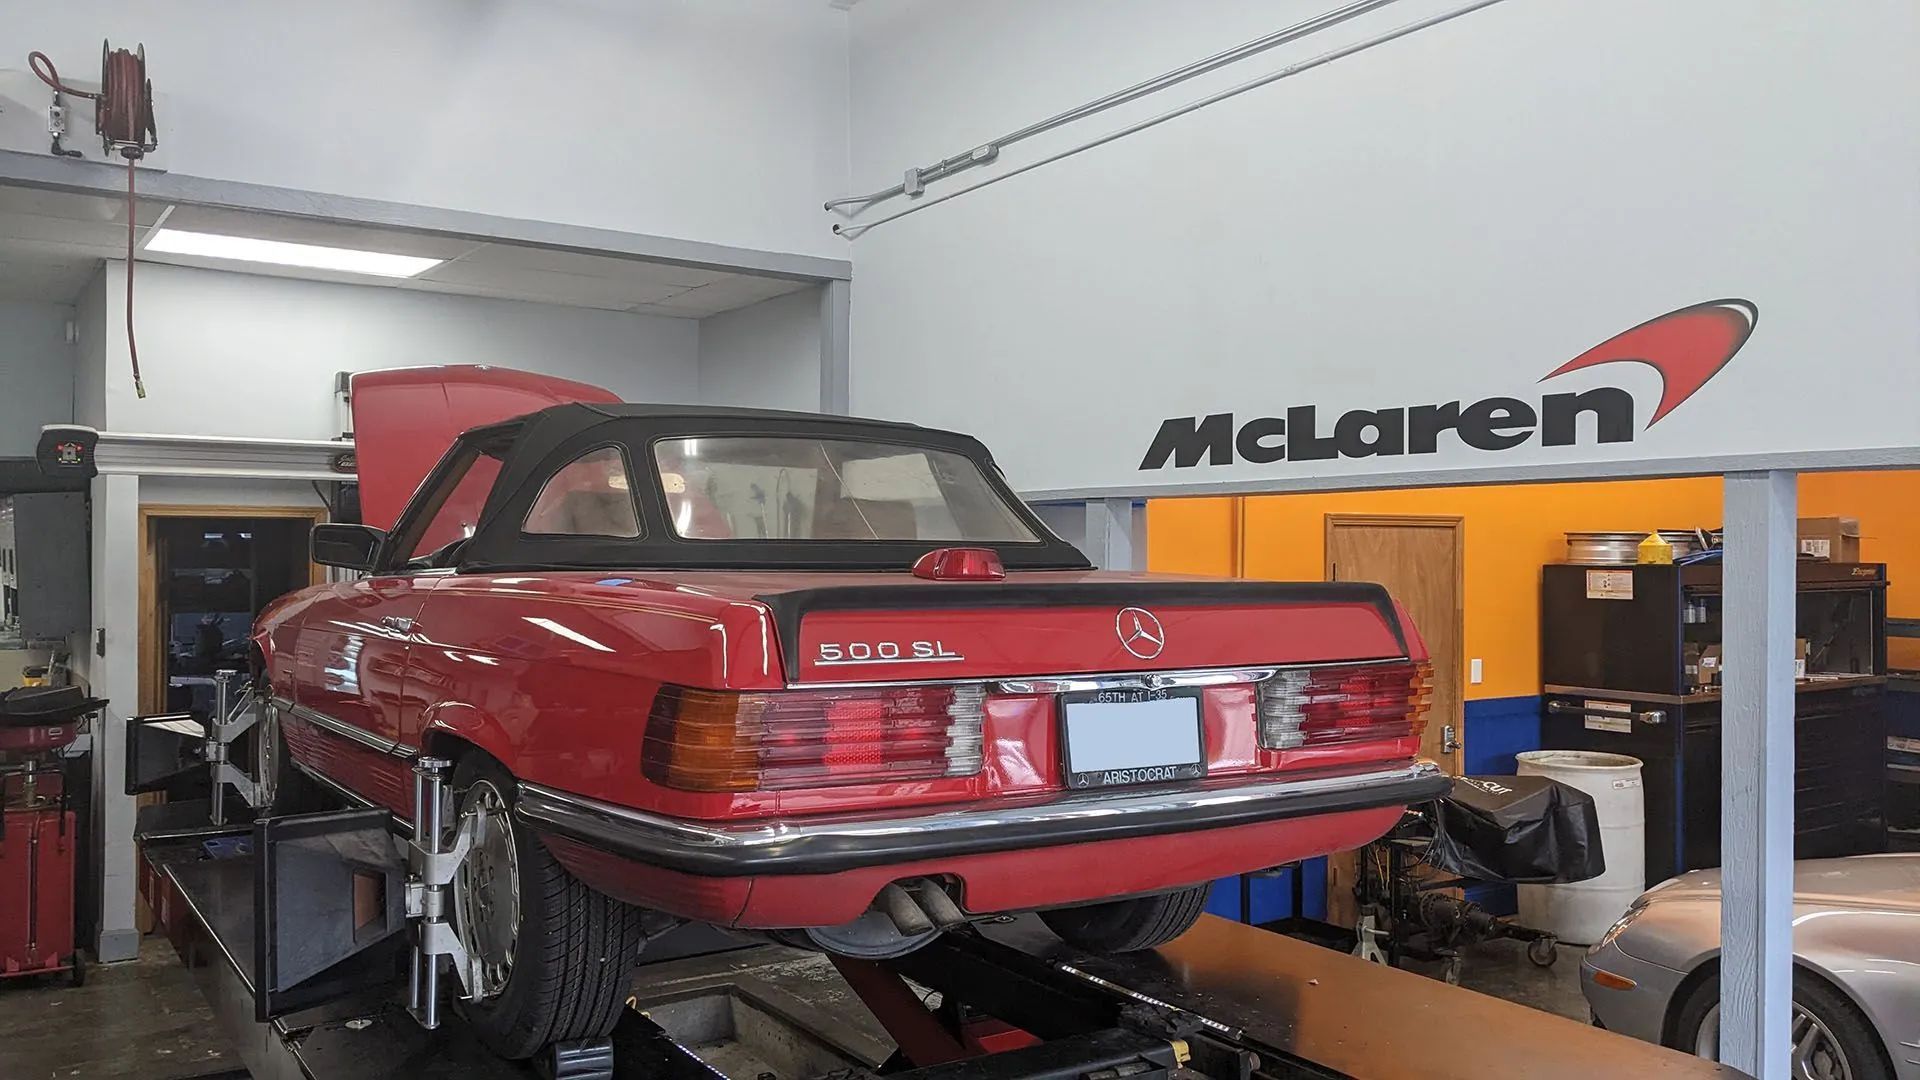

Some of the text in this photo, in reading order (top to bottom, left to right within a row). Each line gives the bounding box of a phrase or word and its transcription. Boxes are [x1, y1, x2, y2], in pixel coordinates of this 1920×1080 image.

[1139, 387, 1634, 470] McLaren
[820, 640, 956, 660] 500 SL
[1098, 691, 1126, 703] 65TH
[1131, 689, 1144, 702] AT
[1103, 765, 1177, 784] ARISTOCRAT
